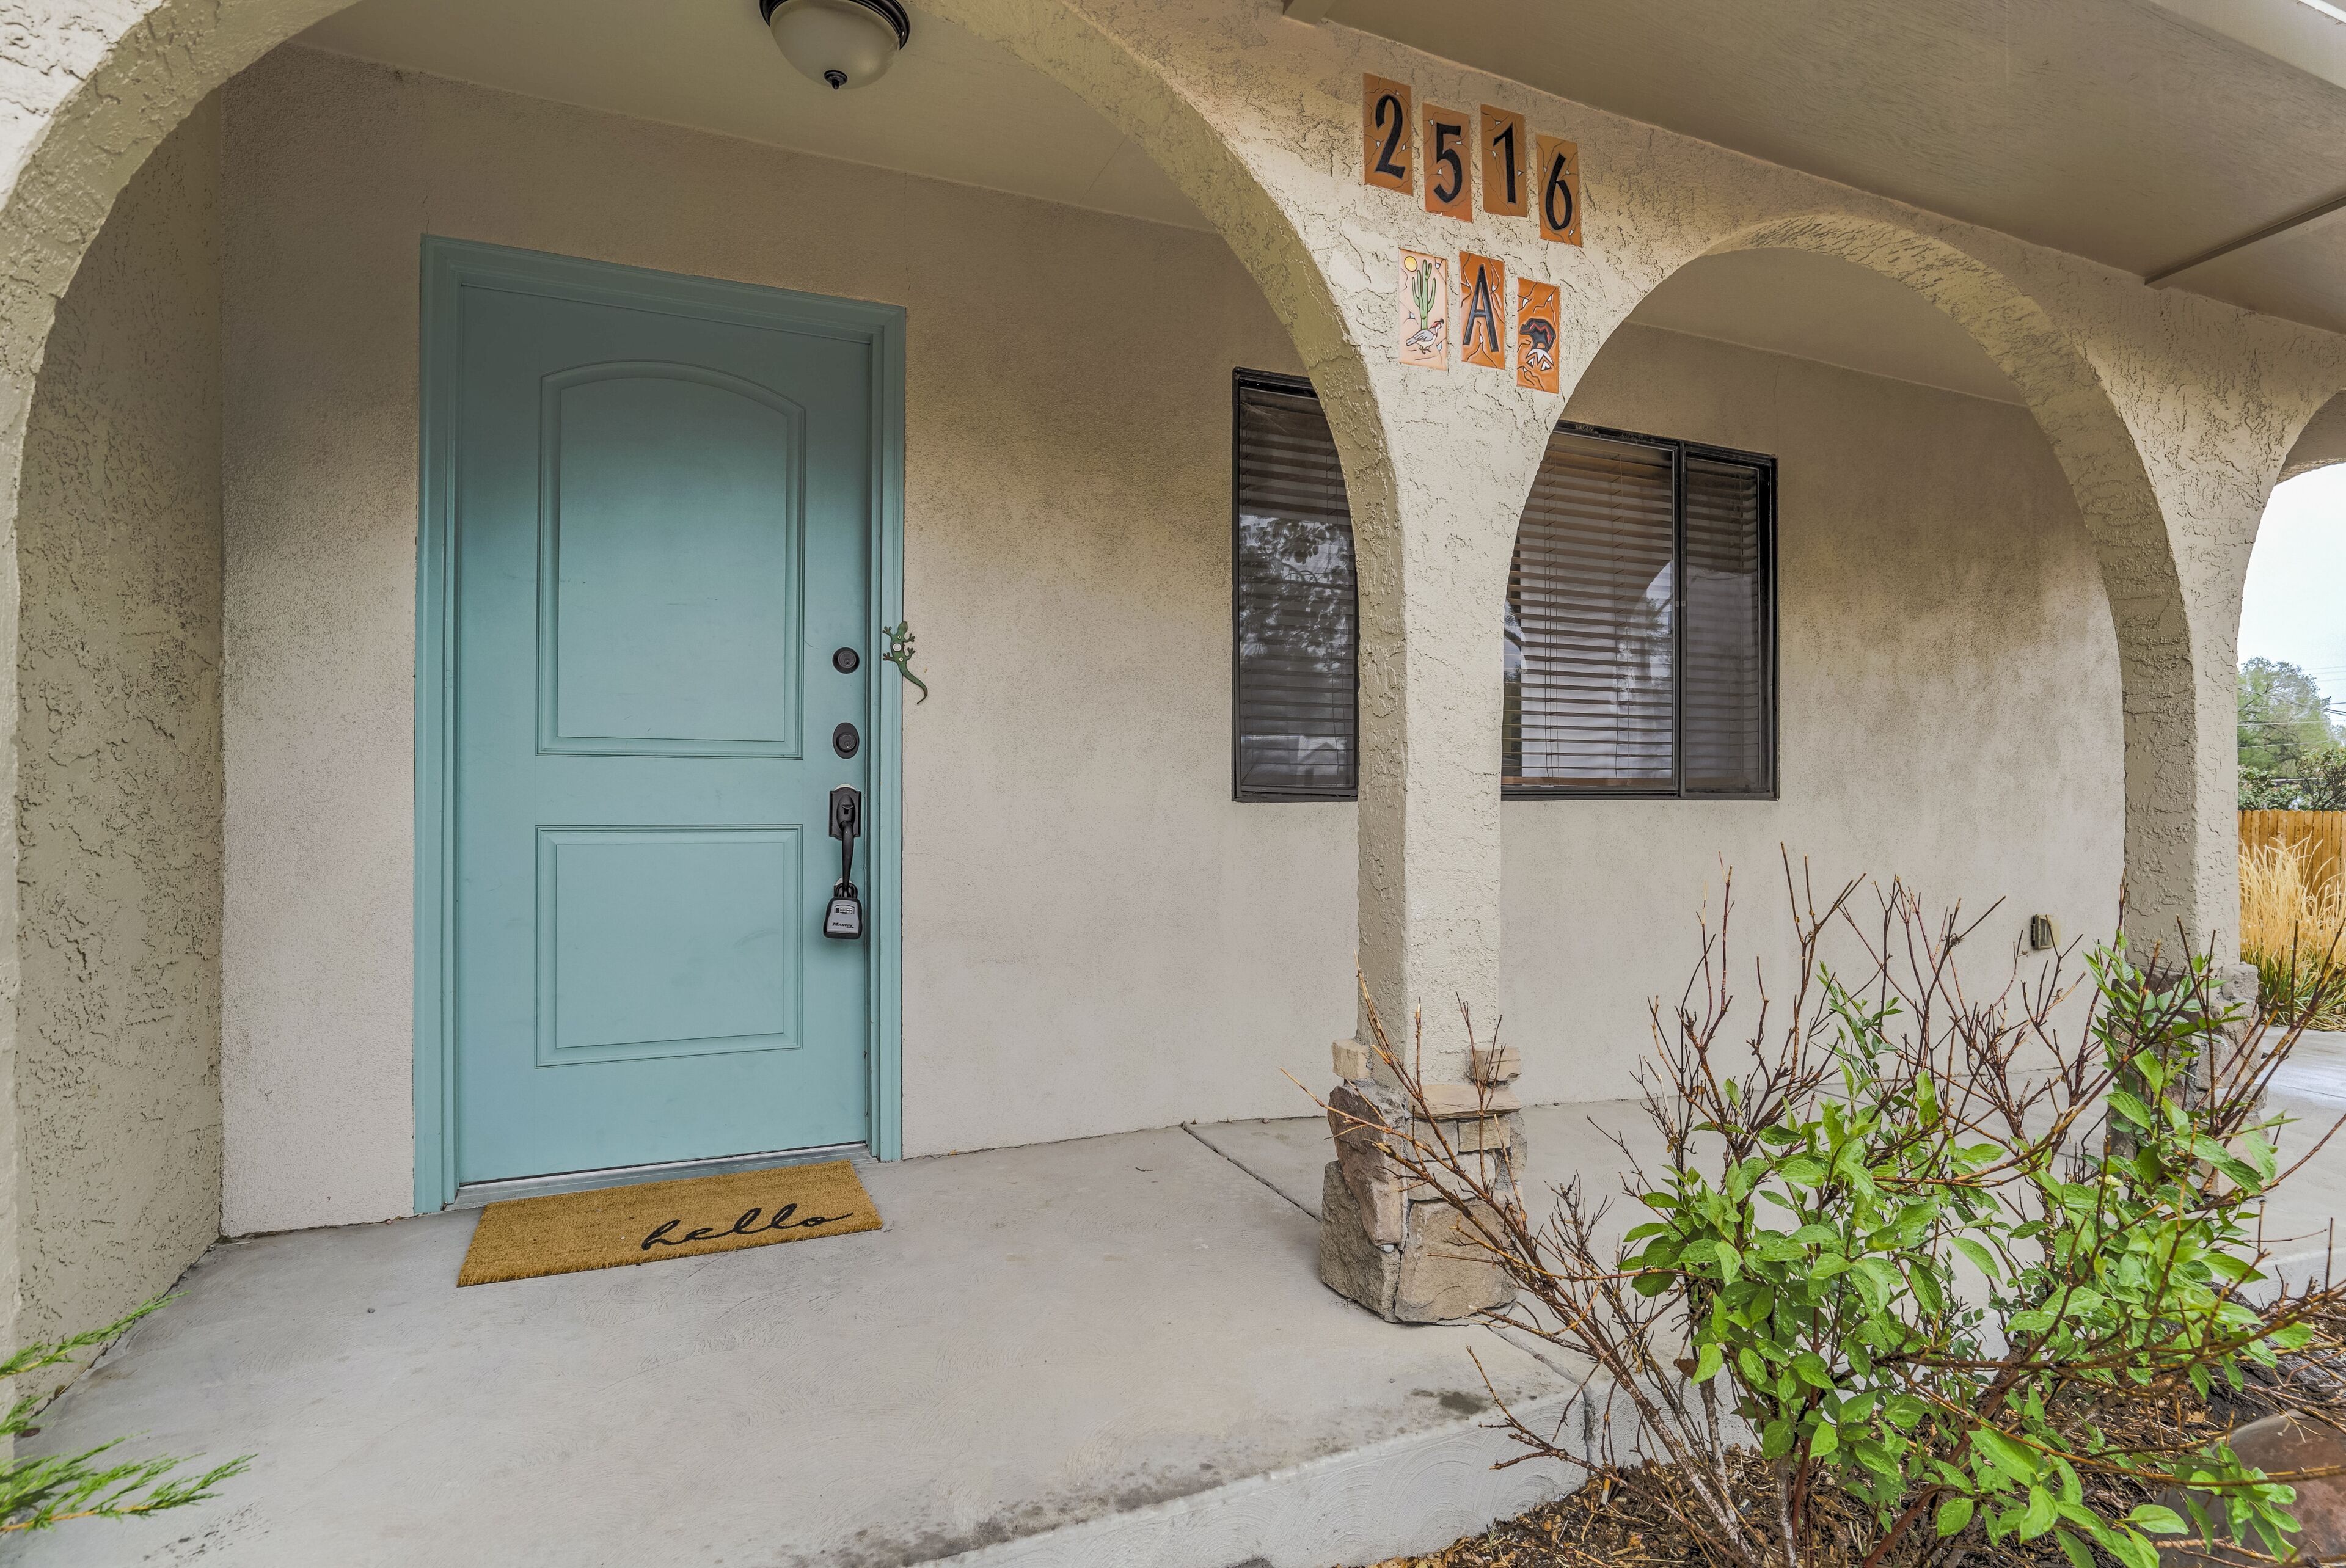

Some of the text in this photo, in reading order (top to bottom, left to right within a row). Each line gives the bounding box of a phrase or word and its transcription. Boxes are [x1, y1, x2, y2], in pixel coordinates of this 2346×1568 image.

[1374, 94, 1573, 231] 2516
[1462, 264, 1499, 352] A
[640, 1203, 854, 1251] hello
